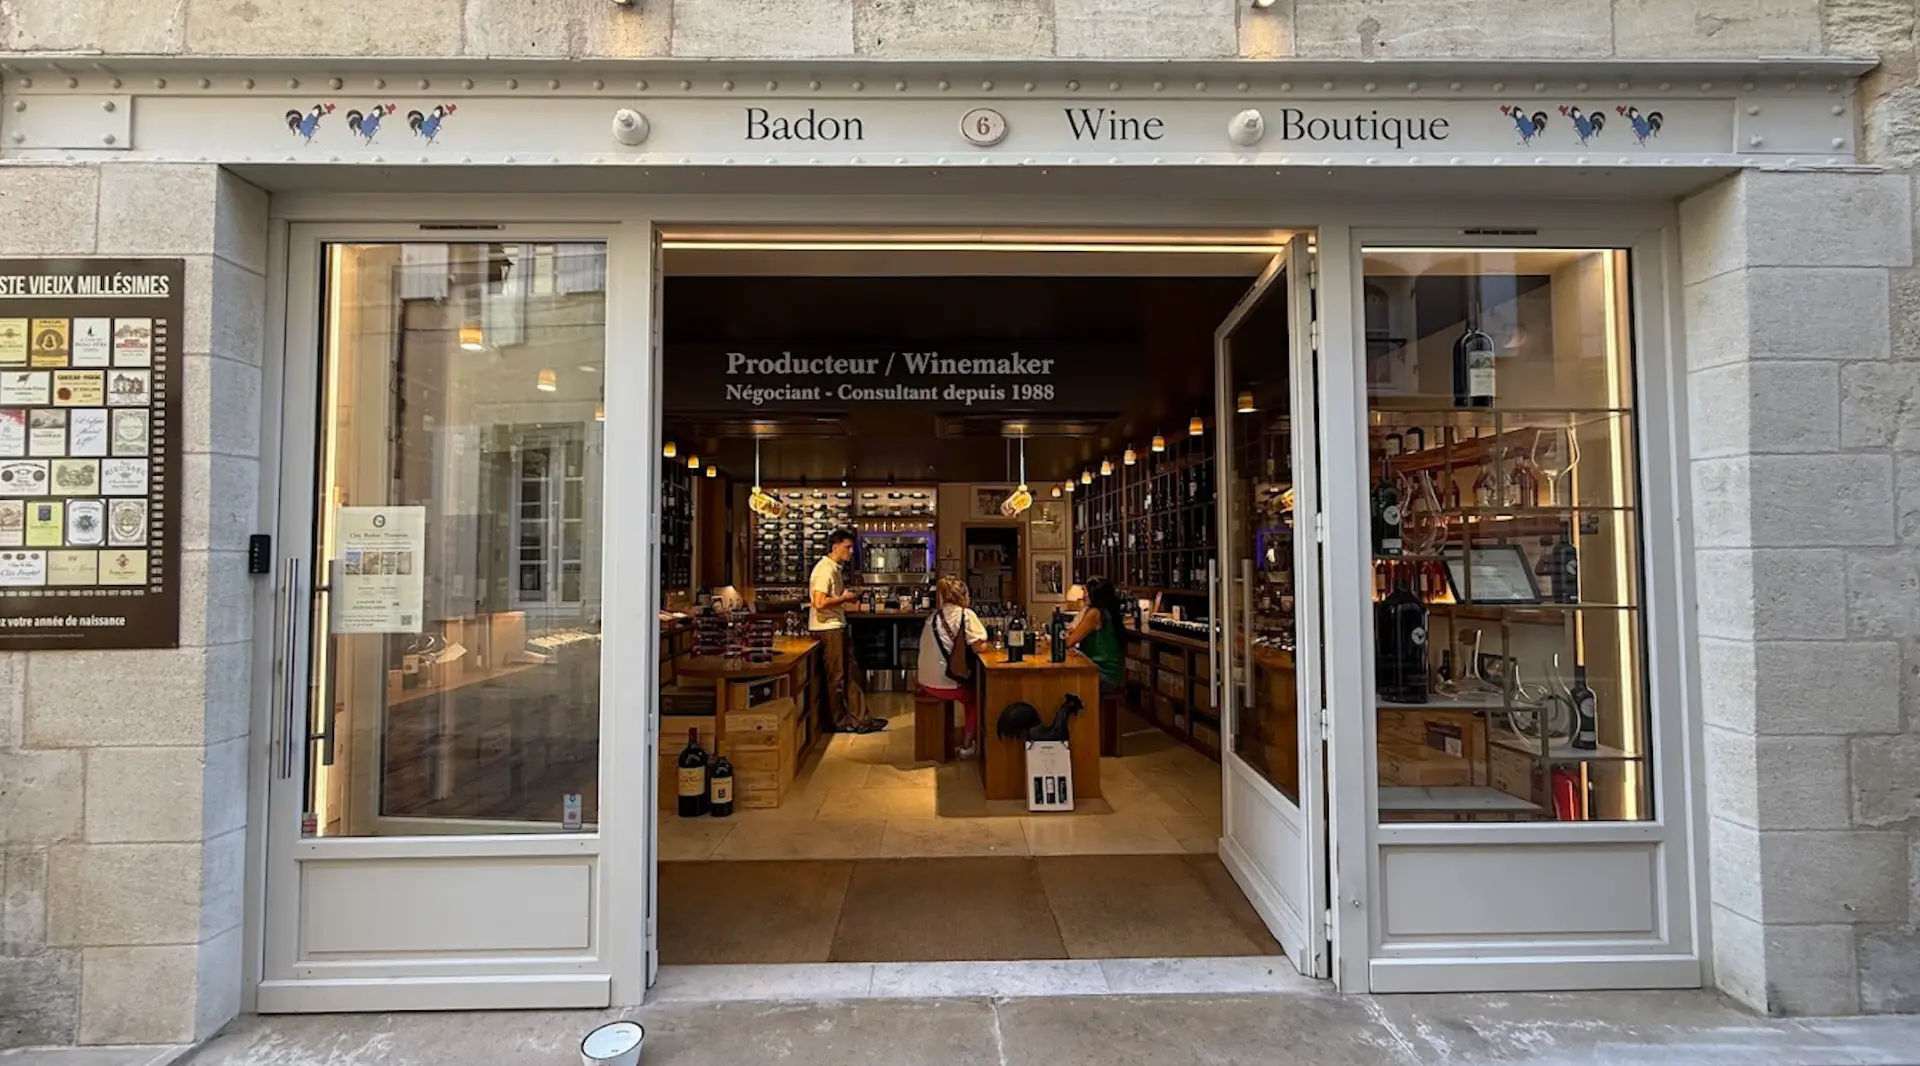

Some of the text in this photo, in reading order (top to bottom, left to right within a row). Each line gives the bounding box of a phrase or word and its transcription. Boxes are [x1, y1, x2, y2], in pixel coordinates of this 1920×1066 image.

[745, 107, 1450, 149] Badon Wine Boutique
[976, 117, 990, 136] 6
[29, 275, 74, 294] VIEUX
[77, 271, 170, 294] MILLÉSIMES
[726, 352, 1055, 376] Producteur / Winemaker
[726, 384, 821, 406] Négociant
[838, 384, 938, 401] Consultant
[943, 384, 1006, 406] depuis
[1011, 384, 1055, 401] 1988
[7, 616, 33, 628] votre
[34, 614, 64, 627] année
[65, 614, 78, 627] de
[79, 614, 126, 627] naissance
